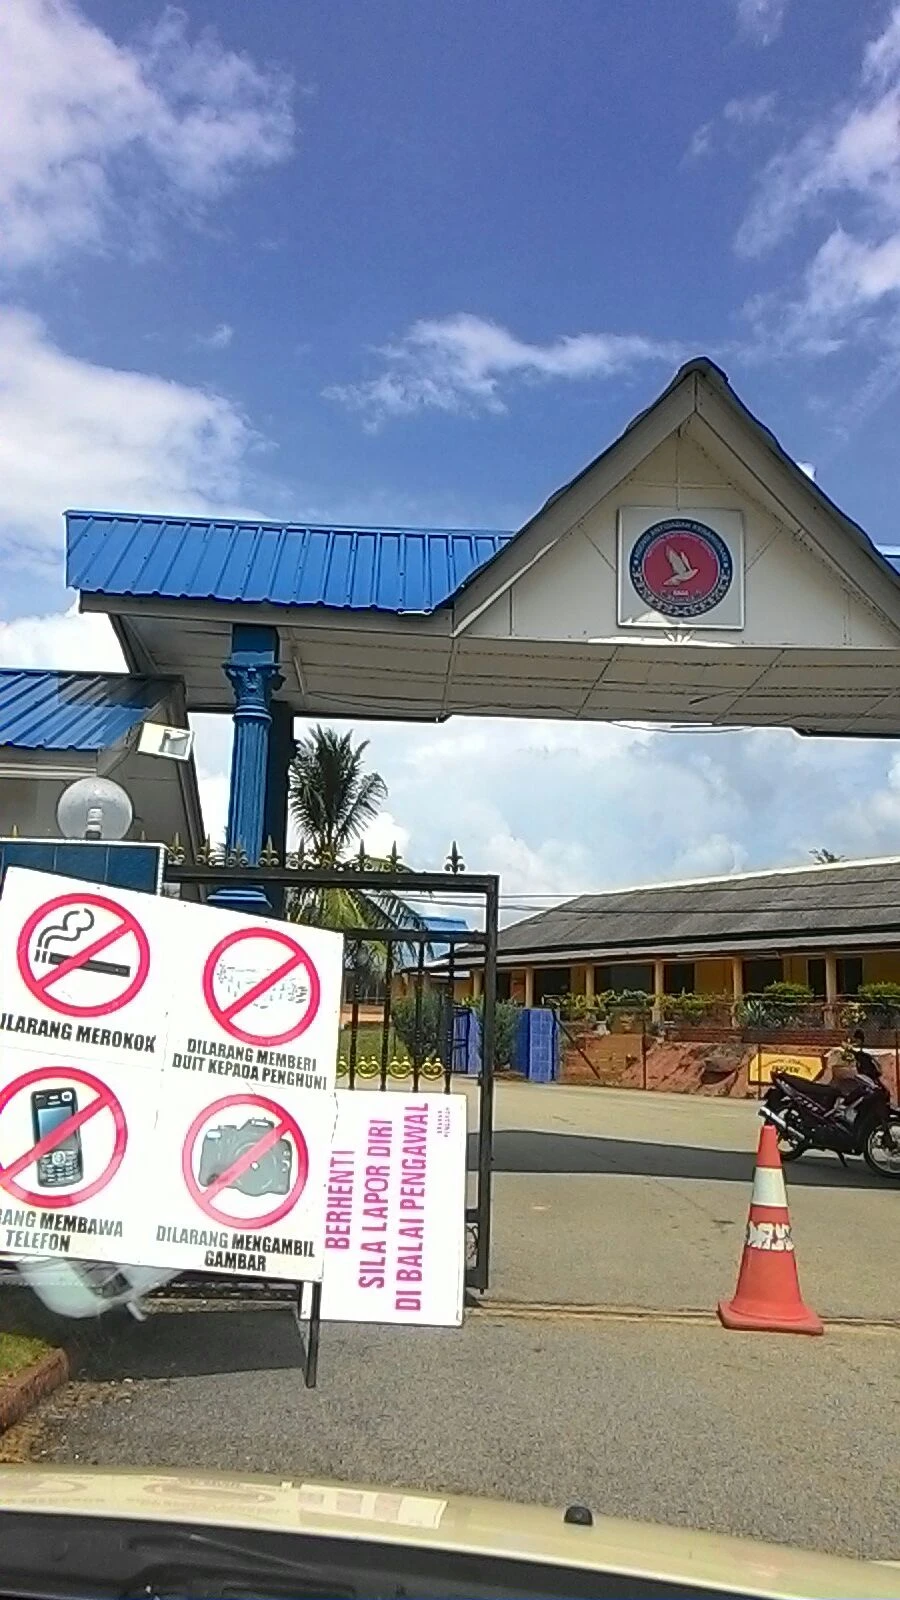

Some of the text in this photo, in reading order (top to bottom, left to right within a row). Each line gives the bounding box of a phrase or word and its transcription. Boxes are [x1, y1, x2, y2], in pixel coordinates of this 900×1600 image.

[76, 1025, 157, 1053] MEROKOK
[187, 1038, 317, 1072] DILARANG MEMBERI
[172, 1053, 327, 1090] DUIT KEPADA PENGHUNI
[325, 1150, 355, 1250] BERHENTI
[358, 1119, 393, 1289] SILA LAPOR DIRI
[395, 1102, 428, 1311] DI BALAI PENGAWAL
[0, 1209, 123, 1237] ANG MEMBAWA
[6, 1229, 71, 1253] TELEFON
[156, 1225, 315, 1257] DILARANG MENGAMBIL
[204, 1250, 267, 1272] GAMBAR
